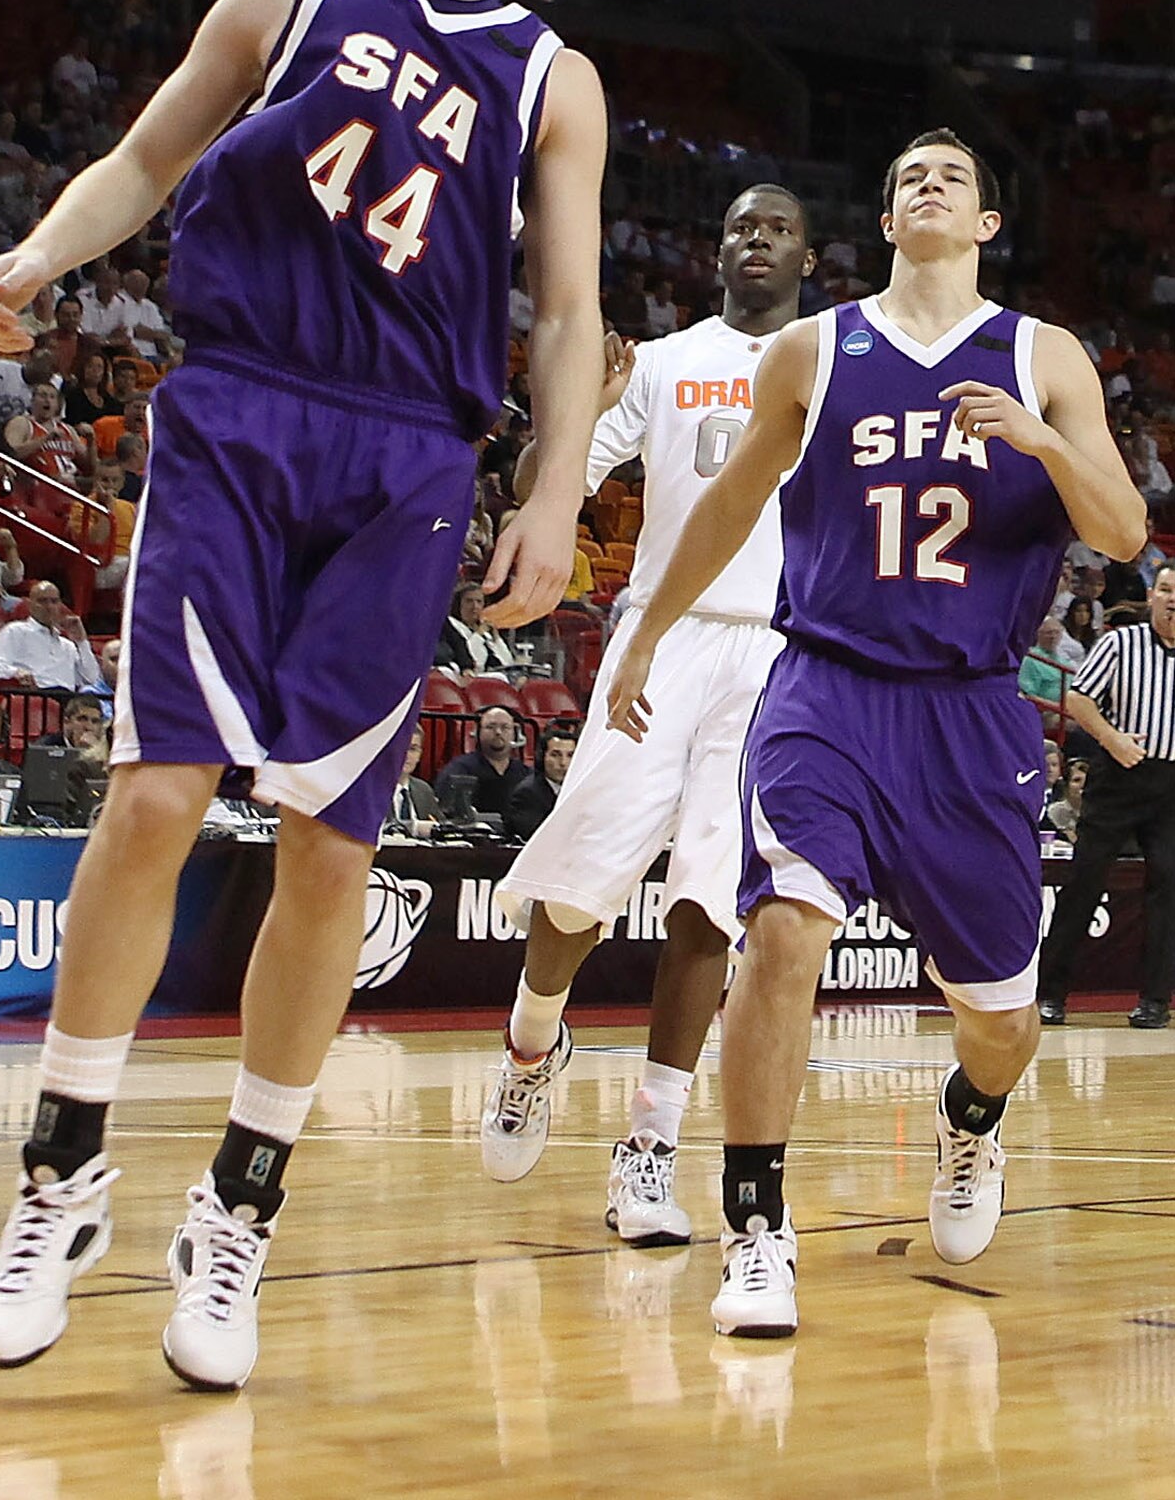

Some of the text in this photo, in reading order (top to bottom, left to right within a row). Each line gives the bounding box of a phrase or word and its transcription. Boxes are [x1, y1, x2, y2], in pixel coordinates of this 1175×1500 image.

[335, 31, 479, 165] SFA
[305, 117, 445, 277] 44
[676, 378, 753, 410] ORA
[852, 410, 990, 472] SFA
[865, 483, 973, 587] 12
[821, 947, 919, 990] LORIDA
